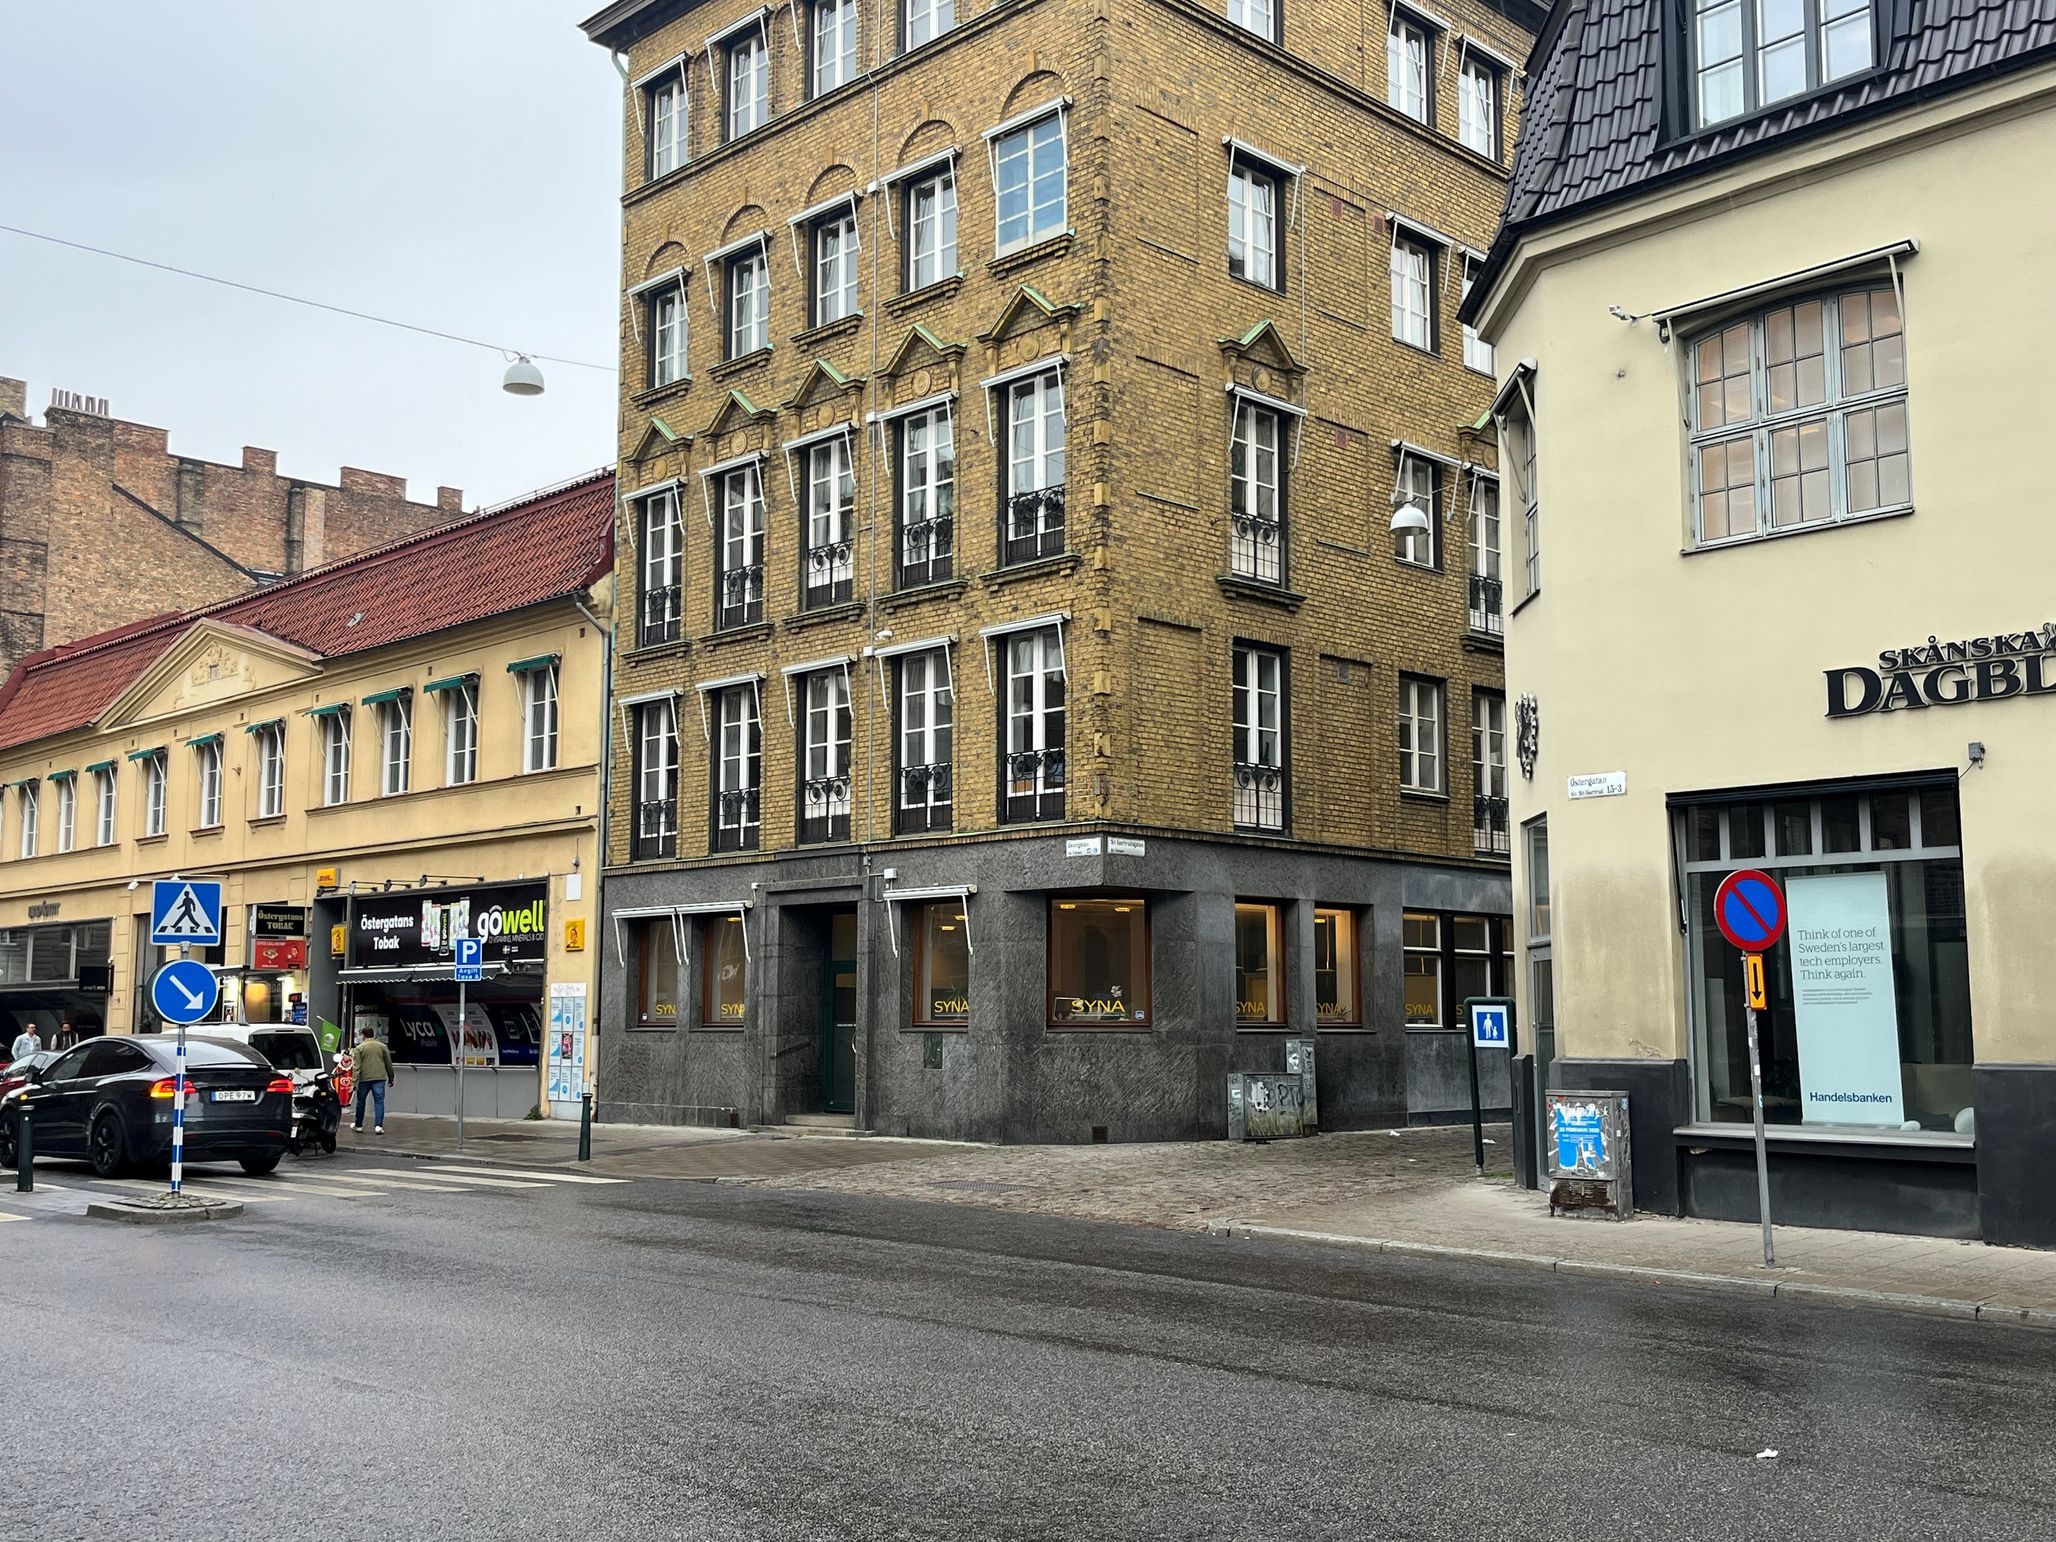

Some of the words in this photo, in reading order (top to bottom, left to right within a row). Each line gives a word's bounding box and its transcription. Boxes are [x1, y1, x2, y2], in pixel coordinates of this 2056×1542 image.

[1878, 631, 2043, 670] SKÅNSKA
[360, 914, 414, 933] Östergatans
[1797, 929, 1830, 940] Think
[1831, 928, 1842, 939] of
[1843, 930, 1864, 938] one
[1865, 927, 1876, 938] of
[373, 935, 400, 950] Tobak
[1798, 942, 1847, 953] Sweden's
[1849, 941, 1884, 953] largest
[462, 941, 478, 963] P
[1799, 956, 1823, 967] tech
[1824, 955, 1883, 968] employers.
[1800, 969, 1833, 980] Think
[1834, 968, 1866, 981] again.
[656, 1004, 677, 1015] SYN
[720, 1003, 744, 1015] SYN
[935, 1000, 968, 1013] SYNA
[1071, 998, 1126, 1013] SYNA
[1404, 1003, 1434, 1016] SYNA
[400, 1018, 436, 1041] Lyca
[218, 1091, 234, 1100] DPE
[1809, 1091, 1893, 1103] Handelsbanken
